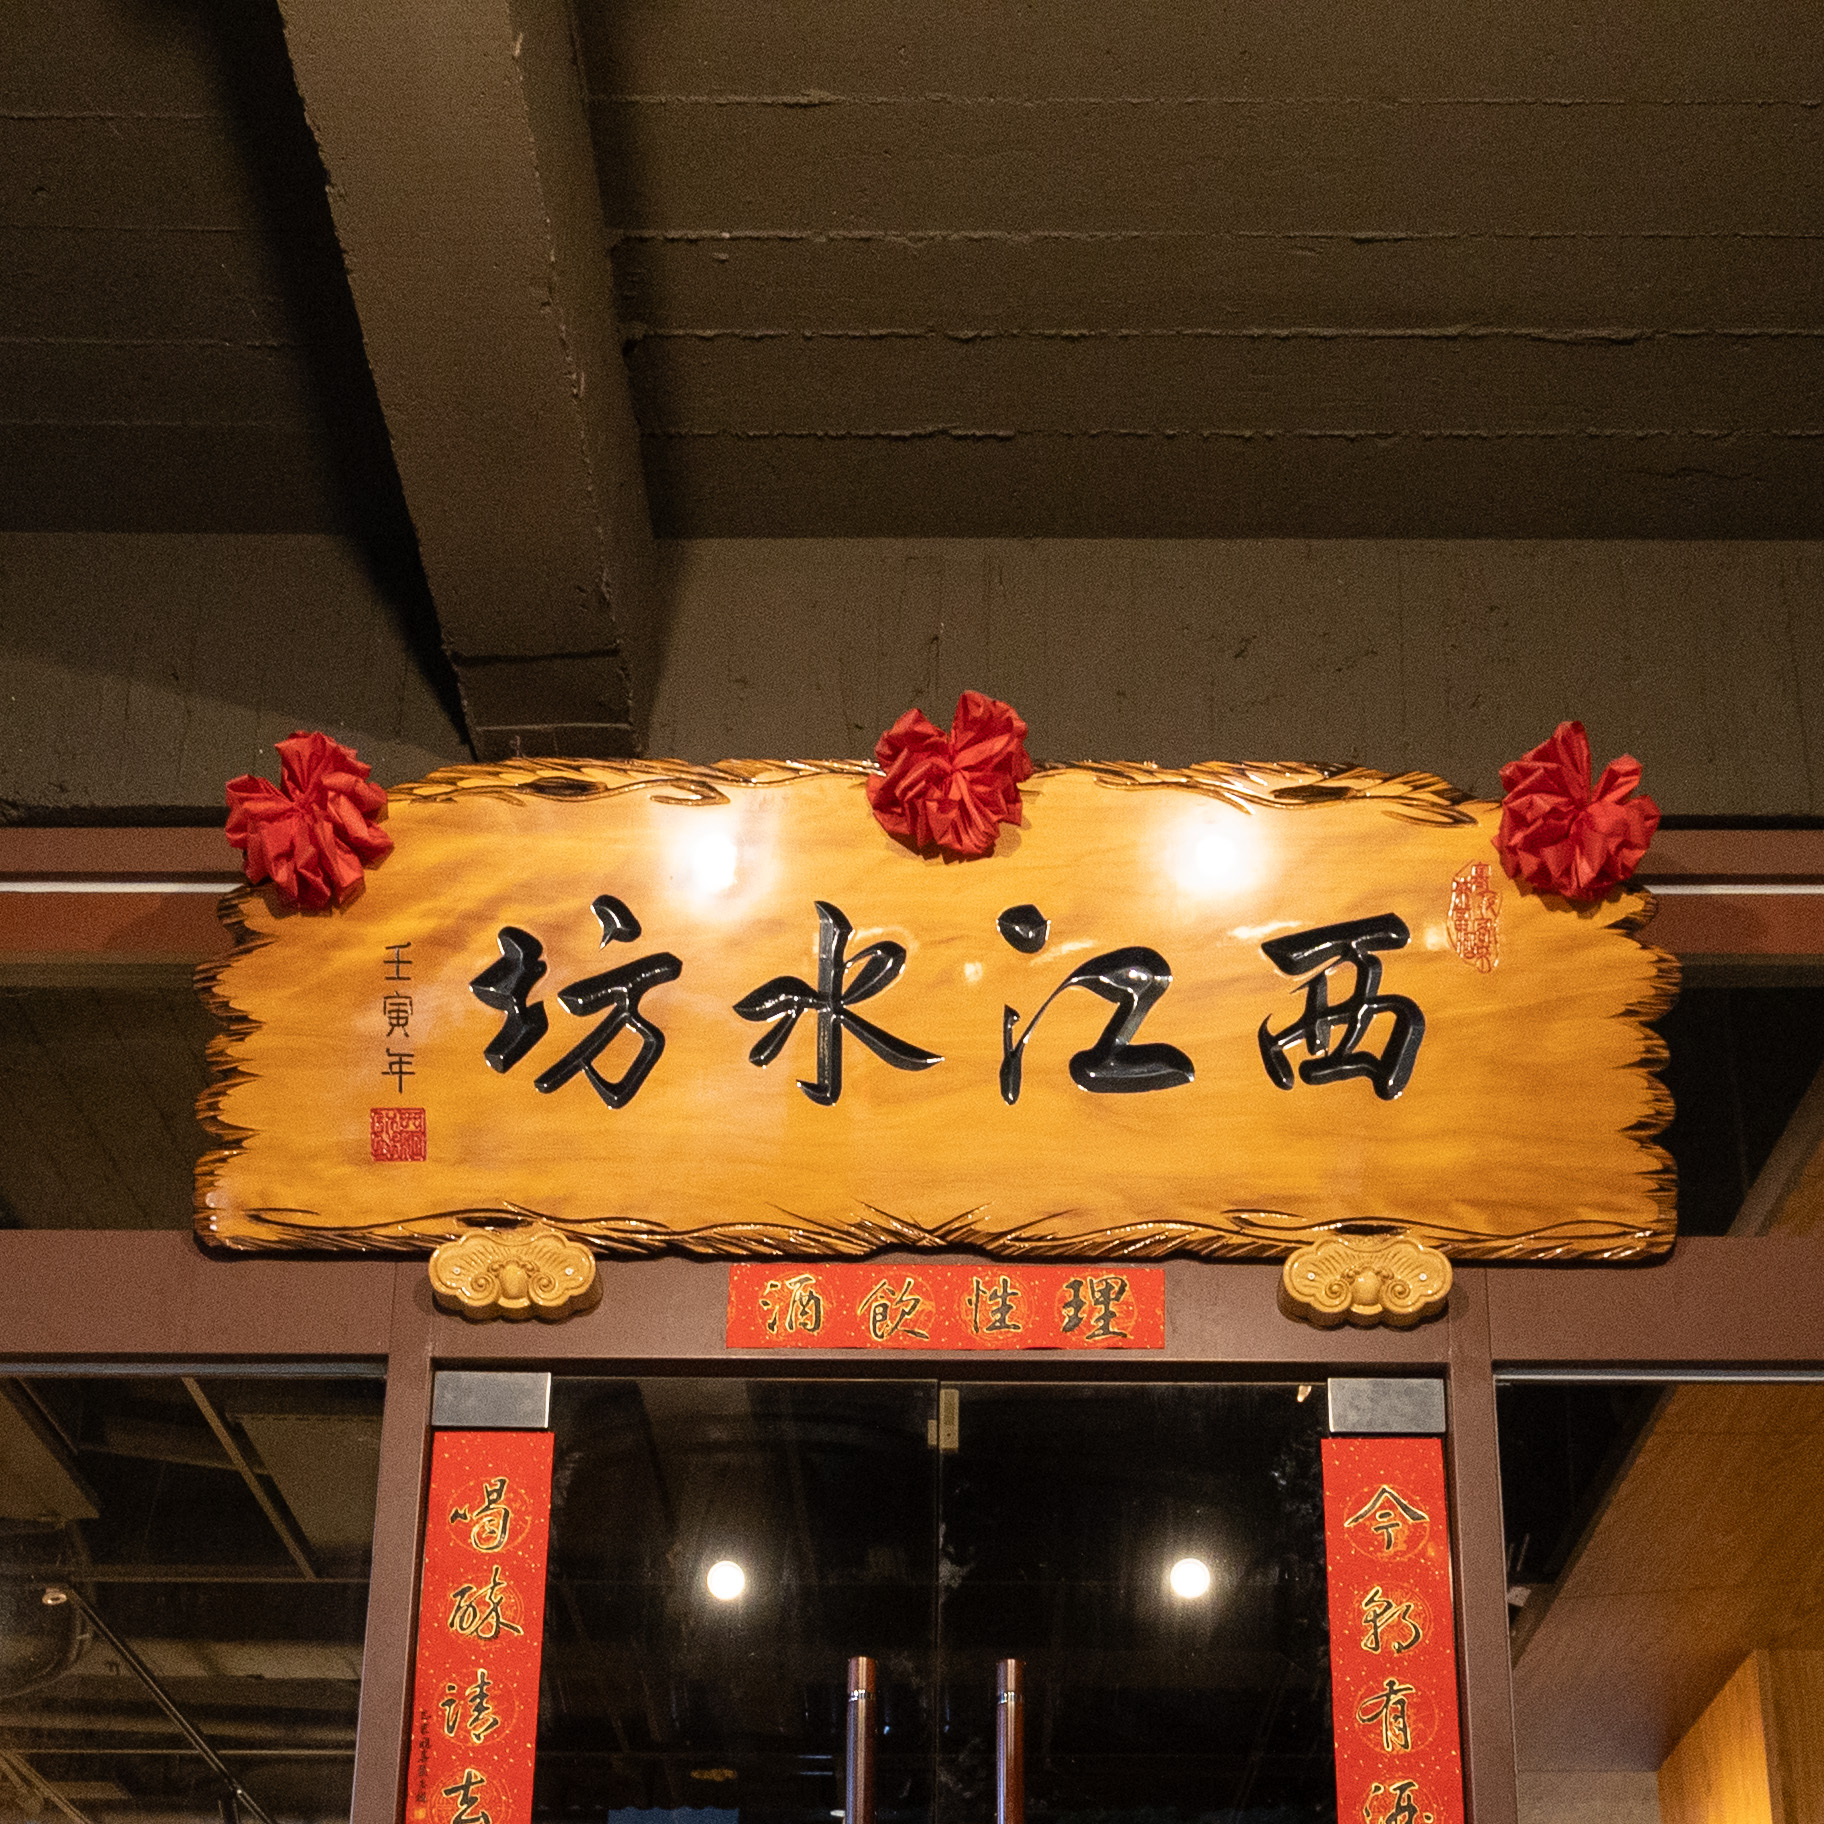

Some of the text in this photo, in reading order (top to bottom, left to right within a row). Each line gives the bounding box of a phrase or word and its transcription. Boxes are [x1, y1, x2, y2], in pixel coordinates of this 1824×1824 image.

[380, 941, 416, 1094] 壬寅年
[469, 894, 1425, 1110] 西江水坊
[760, 1273, 1129, 1341] 理性飲酒
